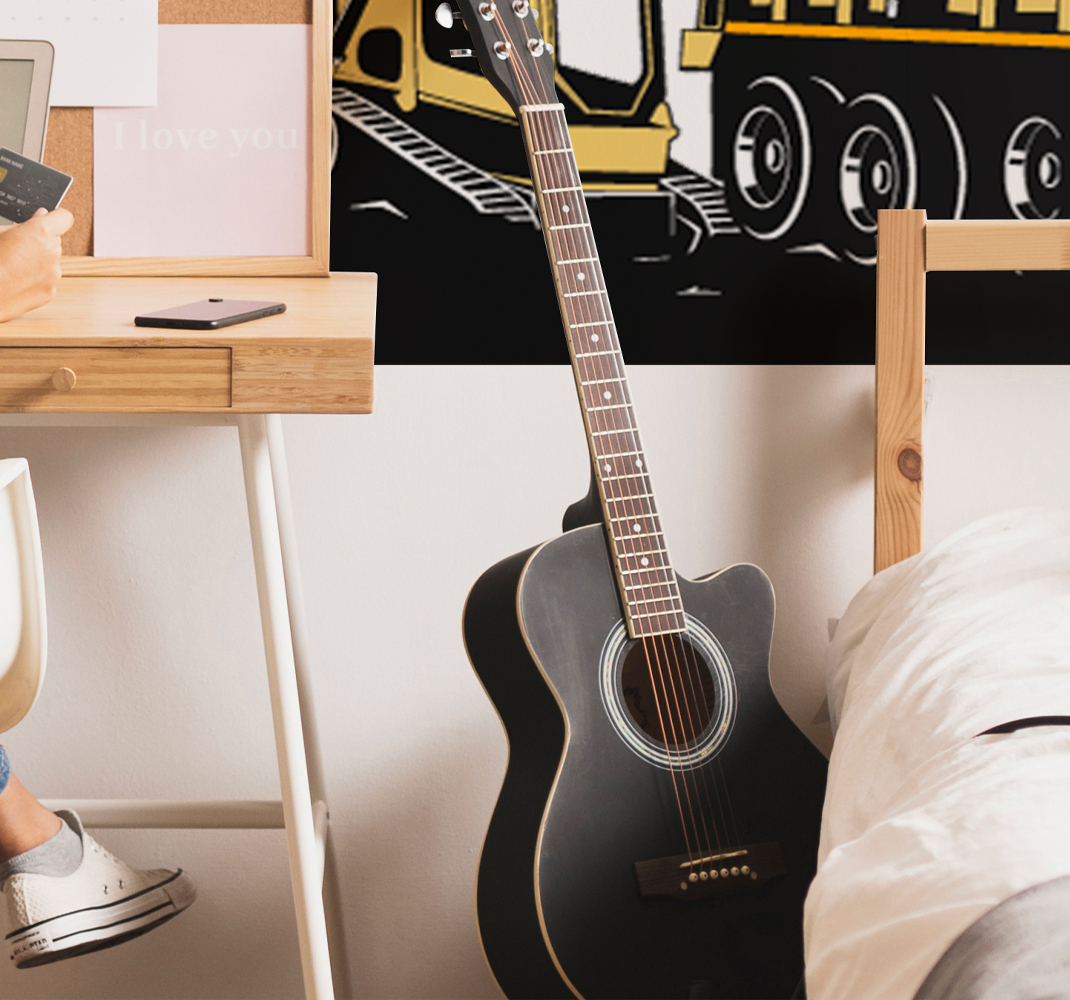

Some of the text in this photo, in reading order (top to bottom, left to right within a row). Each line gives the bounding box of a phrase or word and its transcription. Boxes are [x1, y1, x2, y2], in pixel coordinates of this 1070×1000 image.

[113, 119, 300, 158] I love you
